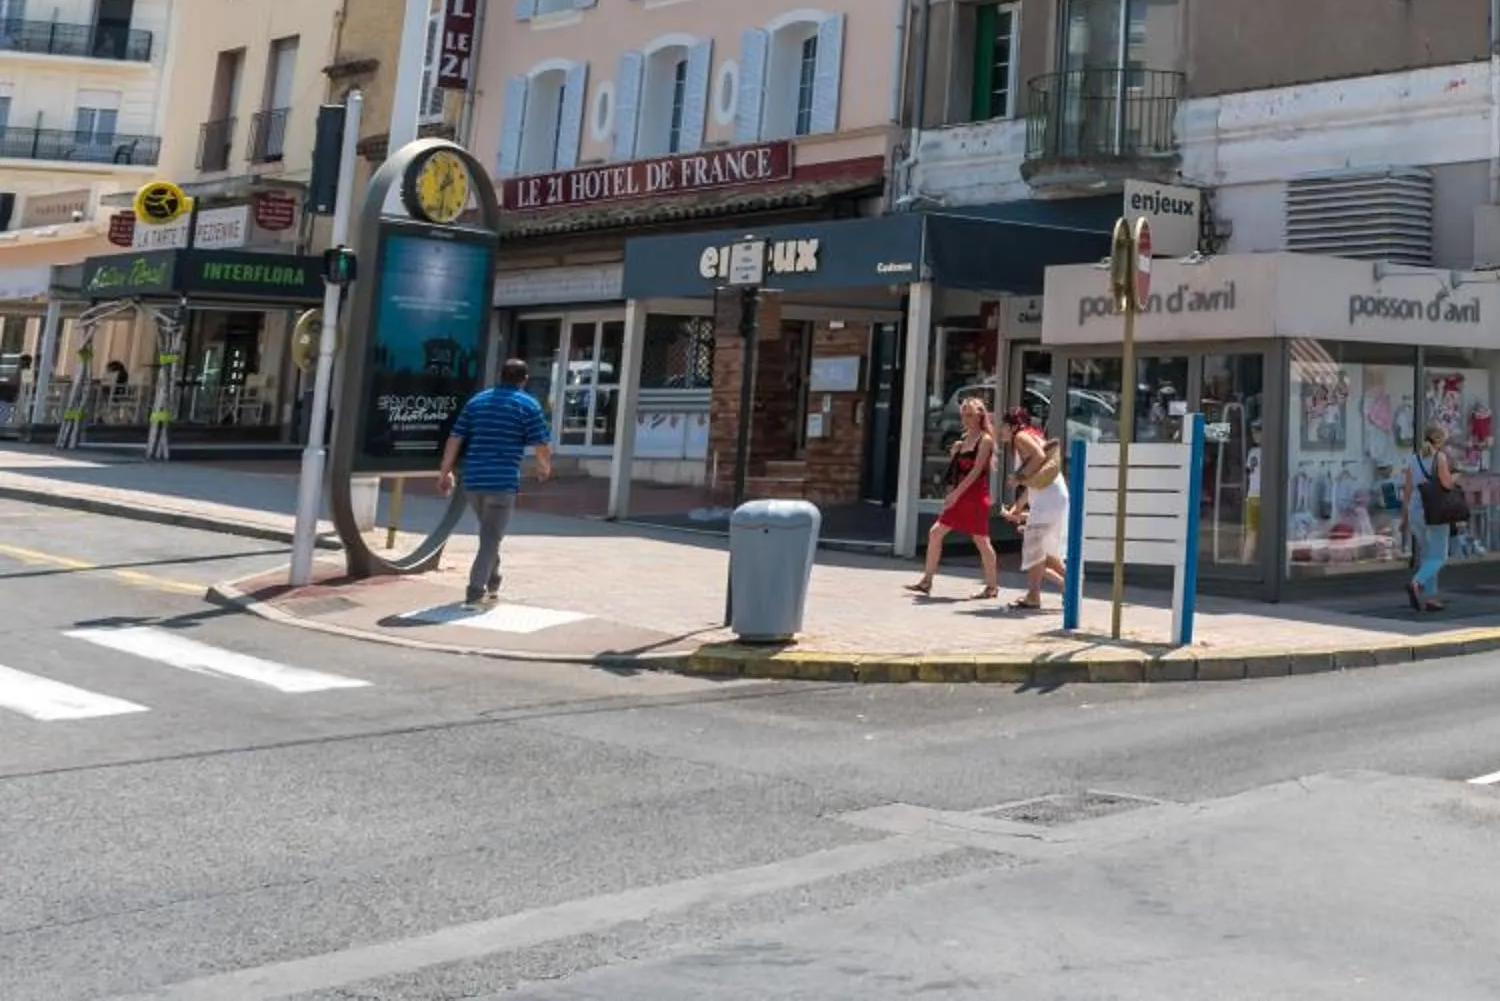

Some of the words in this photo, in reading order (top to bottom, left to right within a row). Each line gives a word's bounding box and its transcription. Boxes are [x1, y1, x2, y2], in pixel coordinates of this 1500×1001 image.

[445, 32, 470, 51] LE
[441, 53, 469, 79] 21
[516, 178, 541, 208] LE
[547, 176, 563, 203] 21
[570, 165, 639, 201] HOTEL
[645, 160, 675, 192] DE
[681, 148, 773, 188] FRANCE
[1131, 190, 1195, 216] enjeux
[202, 262, 305, 285] INTERFLORA
[1166, 281, 1236, 313] d'avril
[1349, 288, 1422, 326] poisson
[1426, 296, 1481, 324] d'avril
